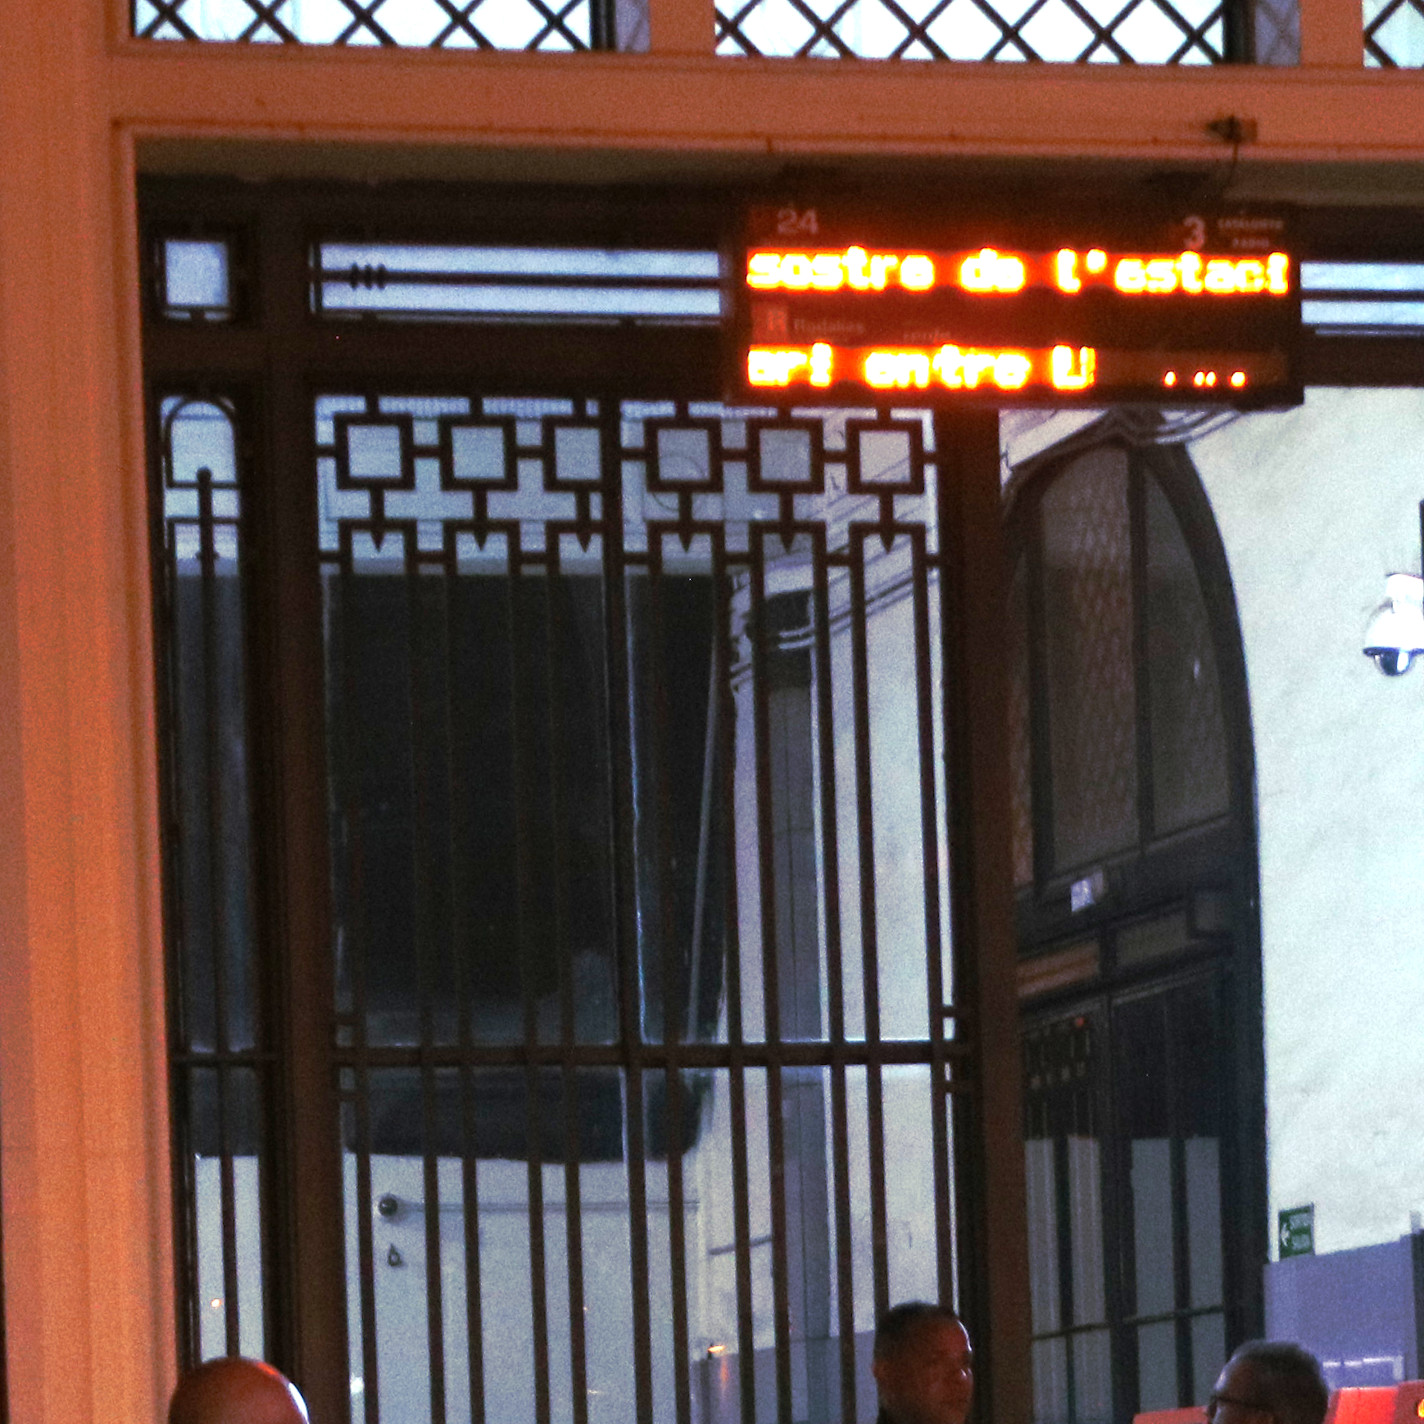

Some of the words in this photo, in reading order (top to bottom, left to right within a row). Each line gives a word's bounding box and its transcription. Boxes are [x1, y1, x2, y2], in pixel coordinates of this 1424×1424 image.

[777, 208, 818, 230] 24
[1182, 216, 1205, 250] 3
[746, 246, 935, 291] sostre
[959, 248, 1025, 292] de
[863, 344, 1031, 389] entre
